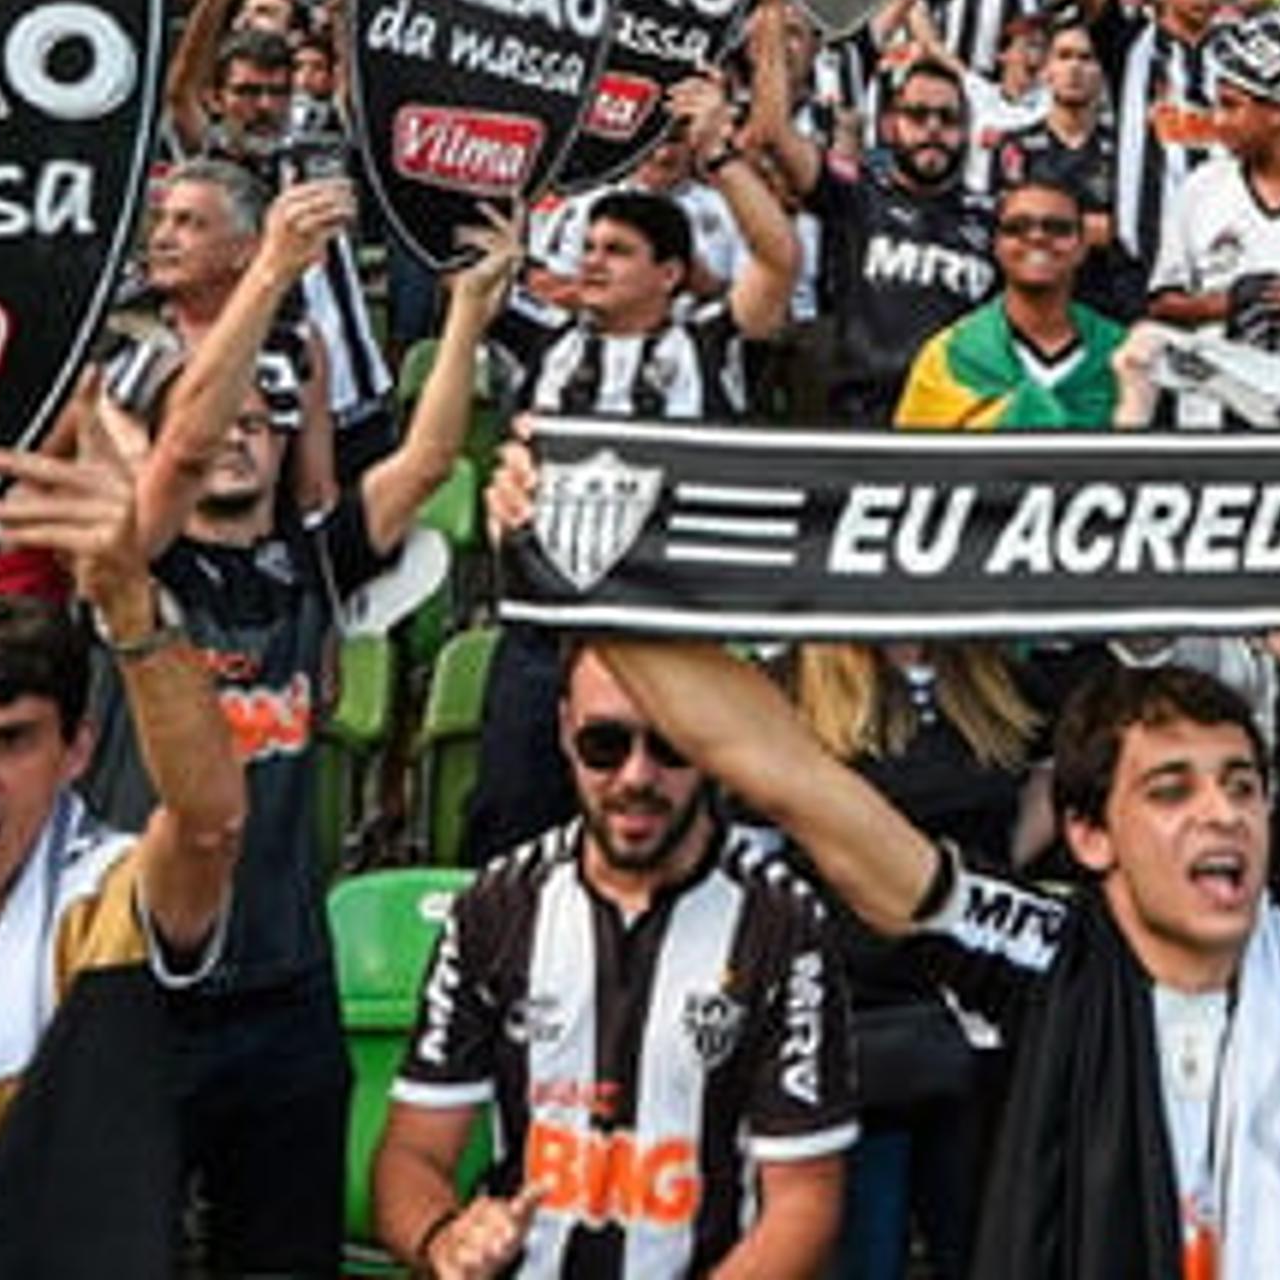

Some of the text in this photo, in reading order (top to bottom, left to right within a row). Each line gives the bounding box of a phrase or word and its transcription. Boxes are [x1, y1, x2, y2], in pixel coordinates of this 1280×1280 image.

[450, 22, 586, 97] massa
[404, 113, 524, 177] Vilma
[862, 234, 995, 302] MRV
[826, 485, 974, 573] EU
[779, 951, 823, 1104] MRV
[526, 1120, 701, 1225] BMG
